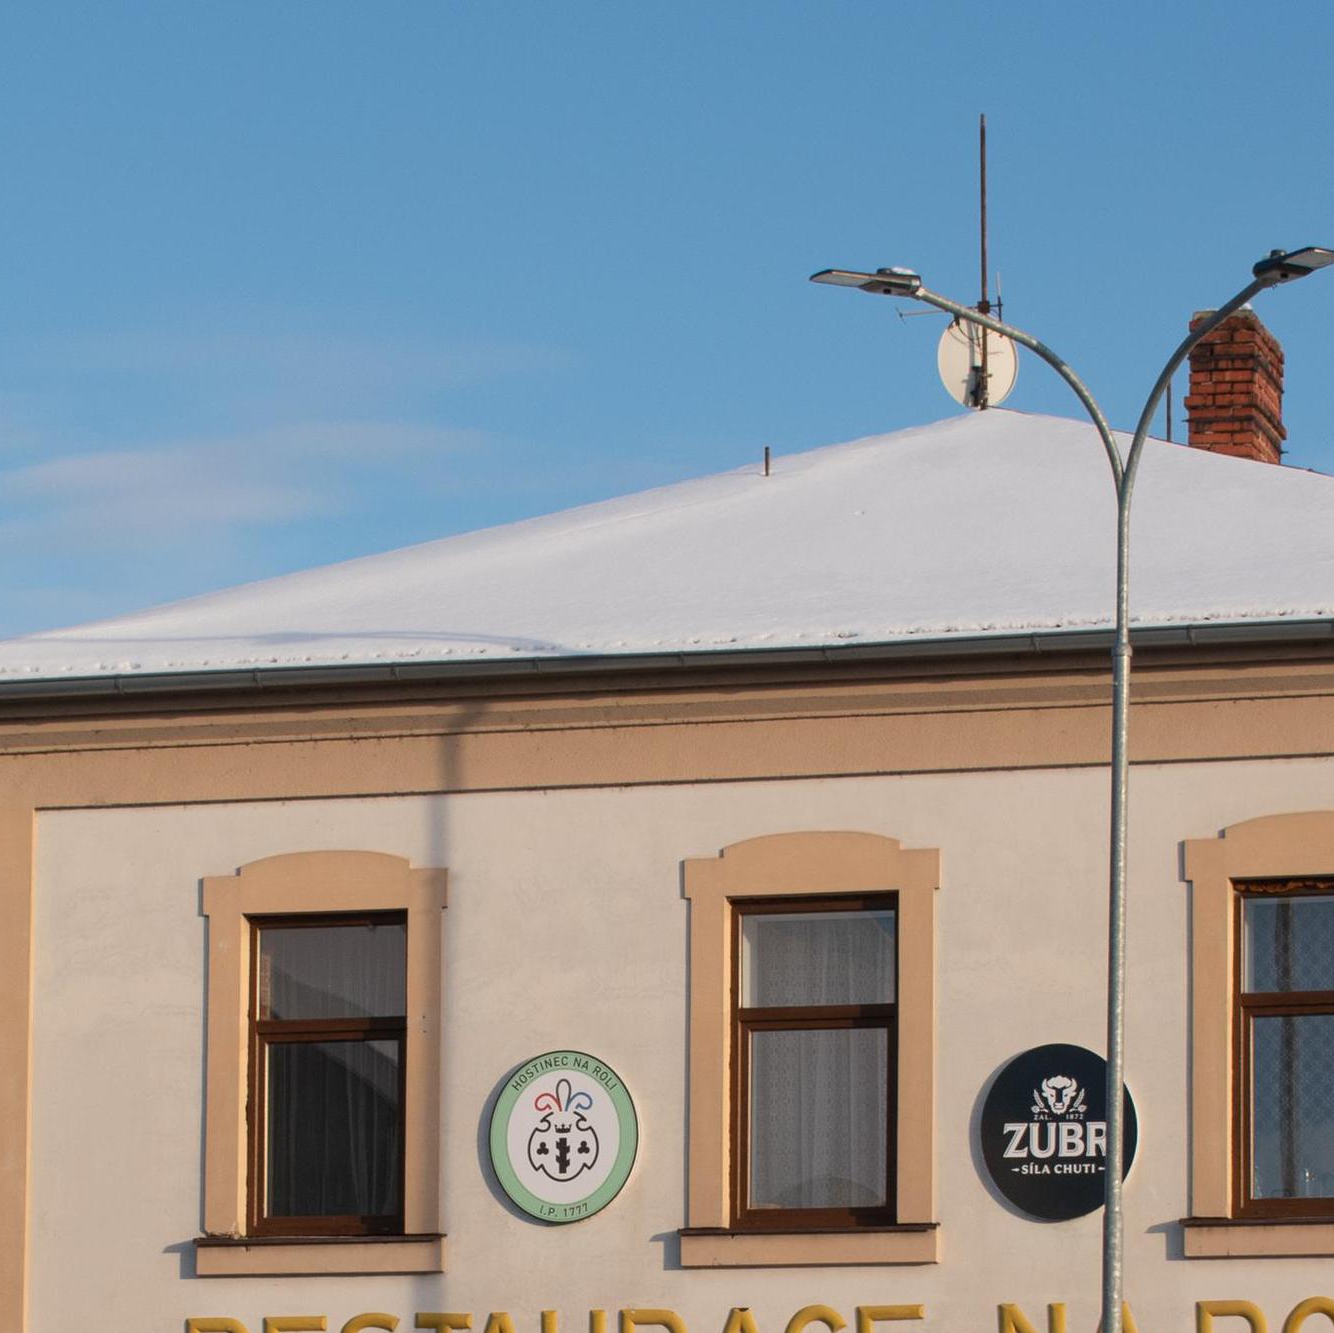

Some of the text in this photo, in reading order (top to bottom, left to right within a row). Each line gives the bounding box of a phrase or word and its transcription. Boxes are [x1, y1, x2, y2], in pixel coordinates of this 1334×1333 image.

[511, 1056, 618, 1092] HOSTINEC NA ROLI
[1002, 1122, 1107, 1158] ZUBR
[1021, 1162, 1096, 1175] SÍLA CHUTI
[563, 1203, 589, 1217] 1777
